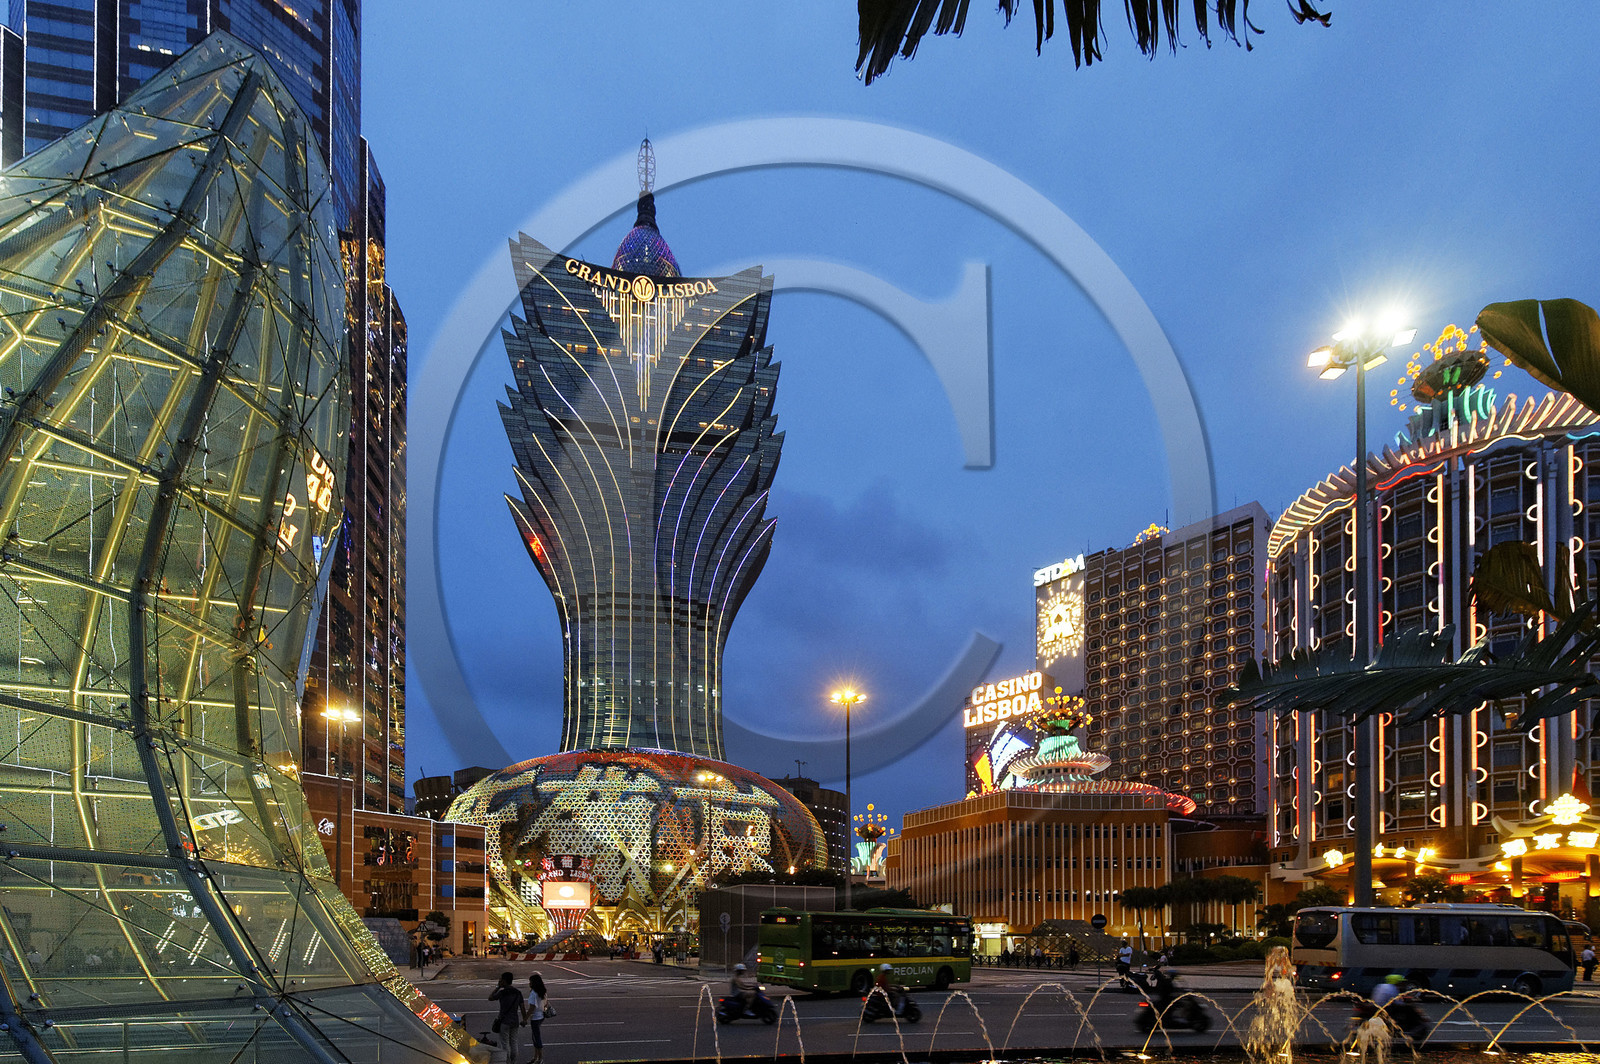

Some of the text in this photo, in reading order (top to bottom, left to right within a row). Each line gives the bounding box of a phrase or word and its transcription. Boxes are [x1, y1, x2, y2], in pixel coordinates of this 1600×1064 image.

[565, 258, 718, 299] GRAND LISBOA
[971, 671, 1042, 705] CASINO
[963, 691, 1042, 728] LISBOA
[893, 966, 934, 976] REOLIAN
